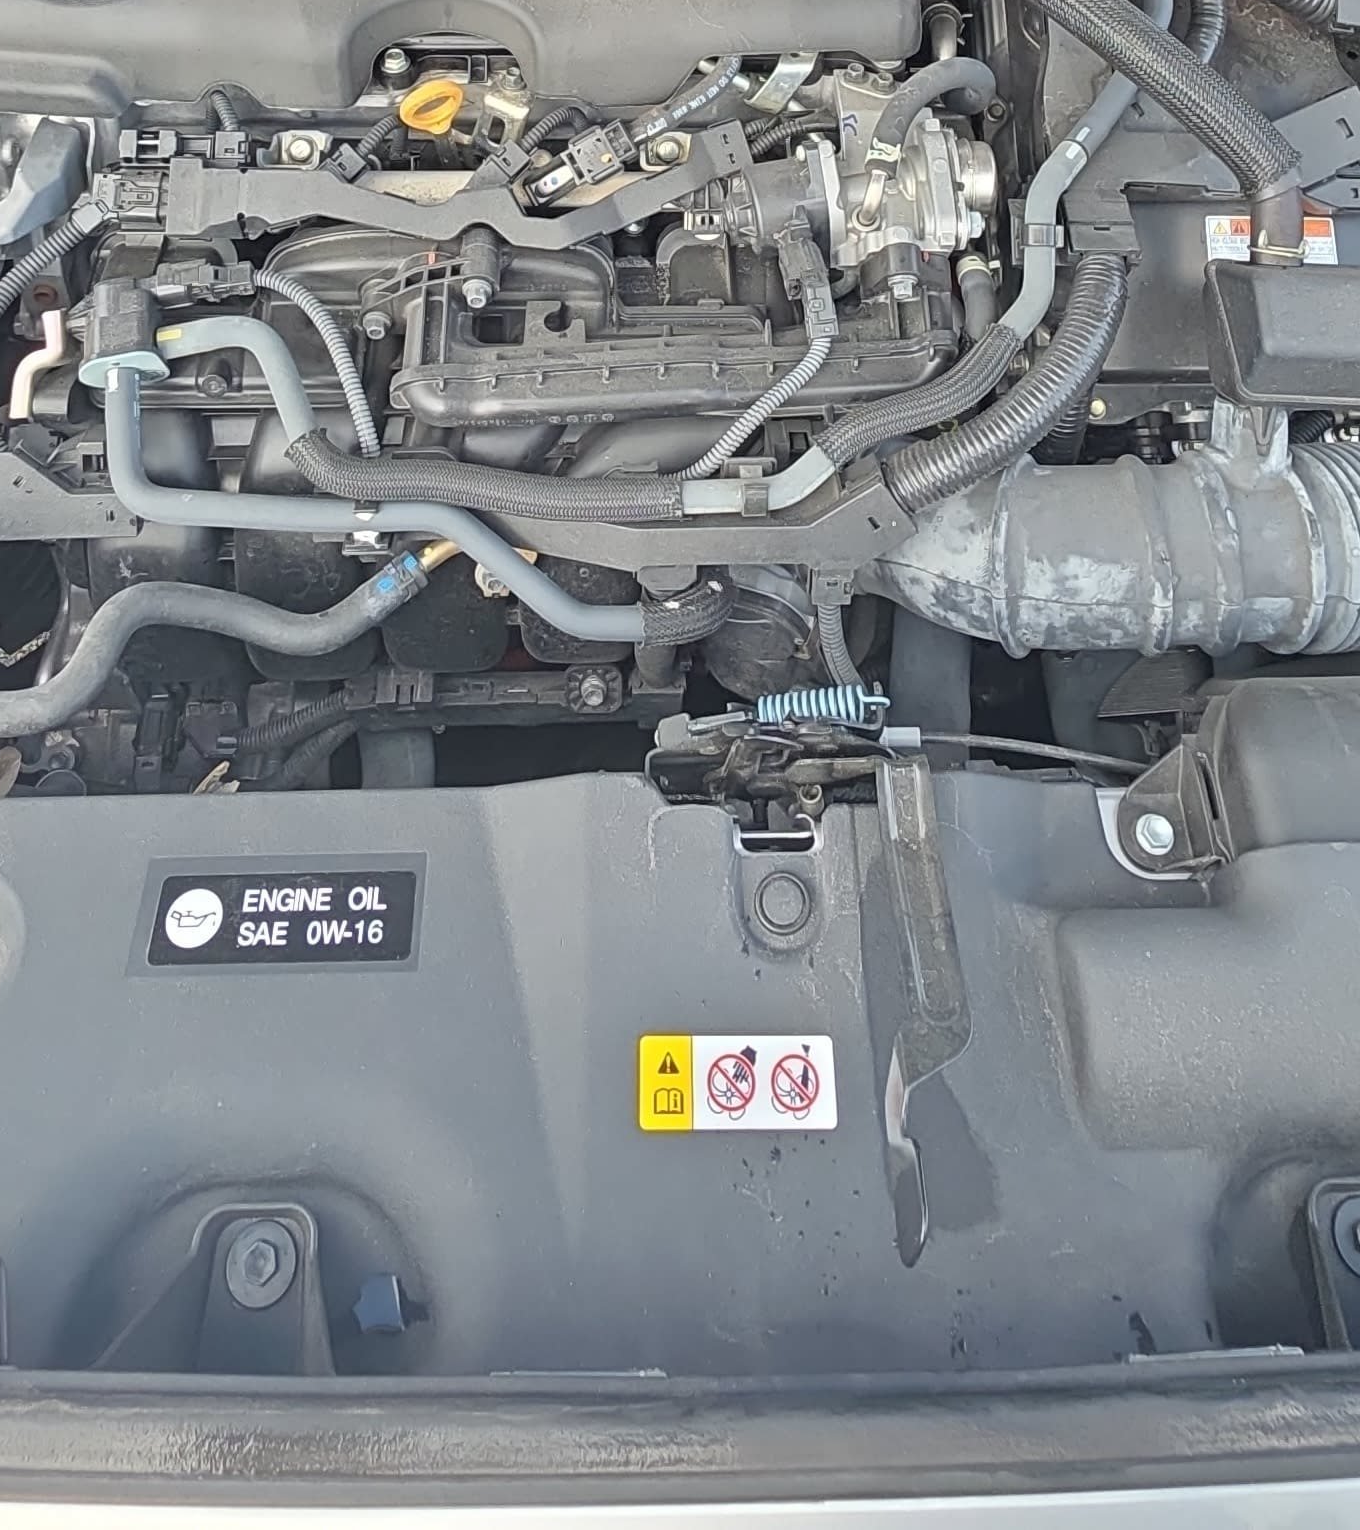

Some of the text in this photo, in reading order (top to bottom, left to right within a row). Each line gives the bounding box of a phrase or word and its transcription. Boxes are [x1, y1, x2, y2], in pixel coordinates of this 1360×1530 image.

[242, 886, 388, 913] ENGINE OIL
[238, 919, 385, 947] SAE 0W-16
